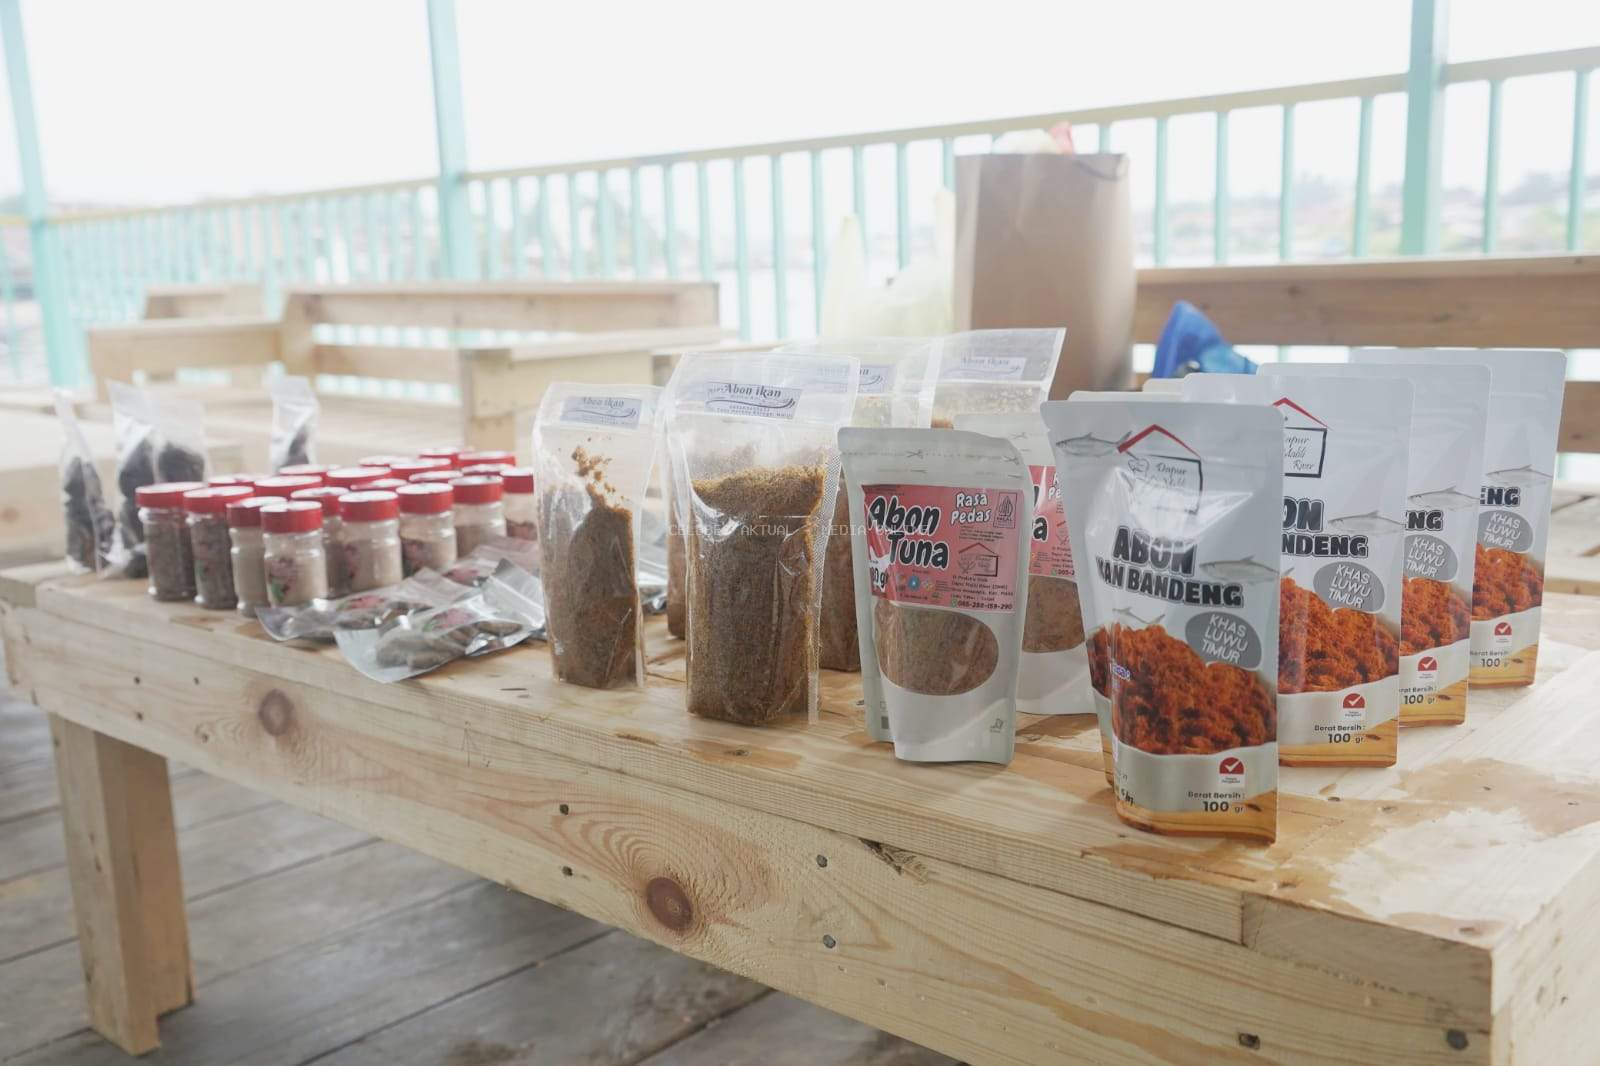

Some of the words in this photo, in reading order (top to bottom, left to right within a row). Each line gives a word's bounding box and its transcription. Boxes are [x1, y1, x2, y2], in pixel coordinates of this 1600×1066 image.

[724, 383, 752, 396] Abon
[955, 492, 988, 508] Rasa
[867, 495, 940, 535] Abon
[950, 508, 992, 525] Pedas
[1490, 512, 1521, 529] KHAS
[1483, 532, 1514, 549] TIMUR
[1486, 522, 1521, 541] LUWU
[888, 531, 949, 569] Tuna
[1113, 526, 1197, 577] ABON
[1412, 537, 1445, 555] KHAS
[1408, 547, 1446, 567] LUWU
[1336, 564, 1370, 584] KHAS
[1406, 560, 1438, 577] TIMUR
[1126, 567, 1244, 608] BANDENG
[1331, 576, 1371, 597] LUWU
[1328, 588, 1363, 608] TIMUR
[1209, 614, 1247, 638] KHAS
[1204, 626, 1248, 652] LUWU
[1201, 639, 1241, 663] TIMUR
[1481, 658, 1500, 667] 100
[1404, 694, 1424, 705] 100
[1328, 733, 1351, 744] 100
[1187, 790, 1212, 799] Berat
[1202, 801, 1229, 813] 100
